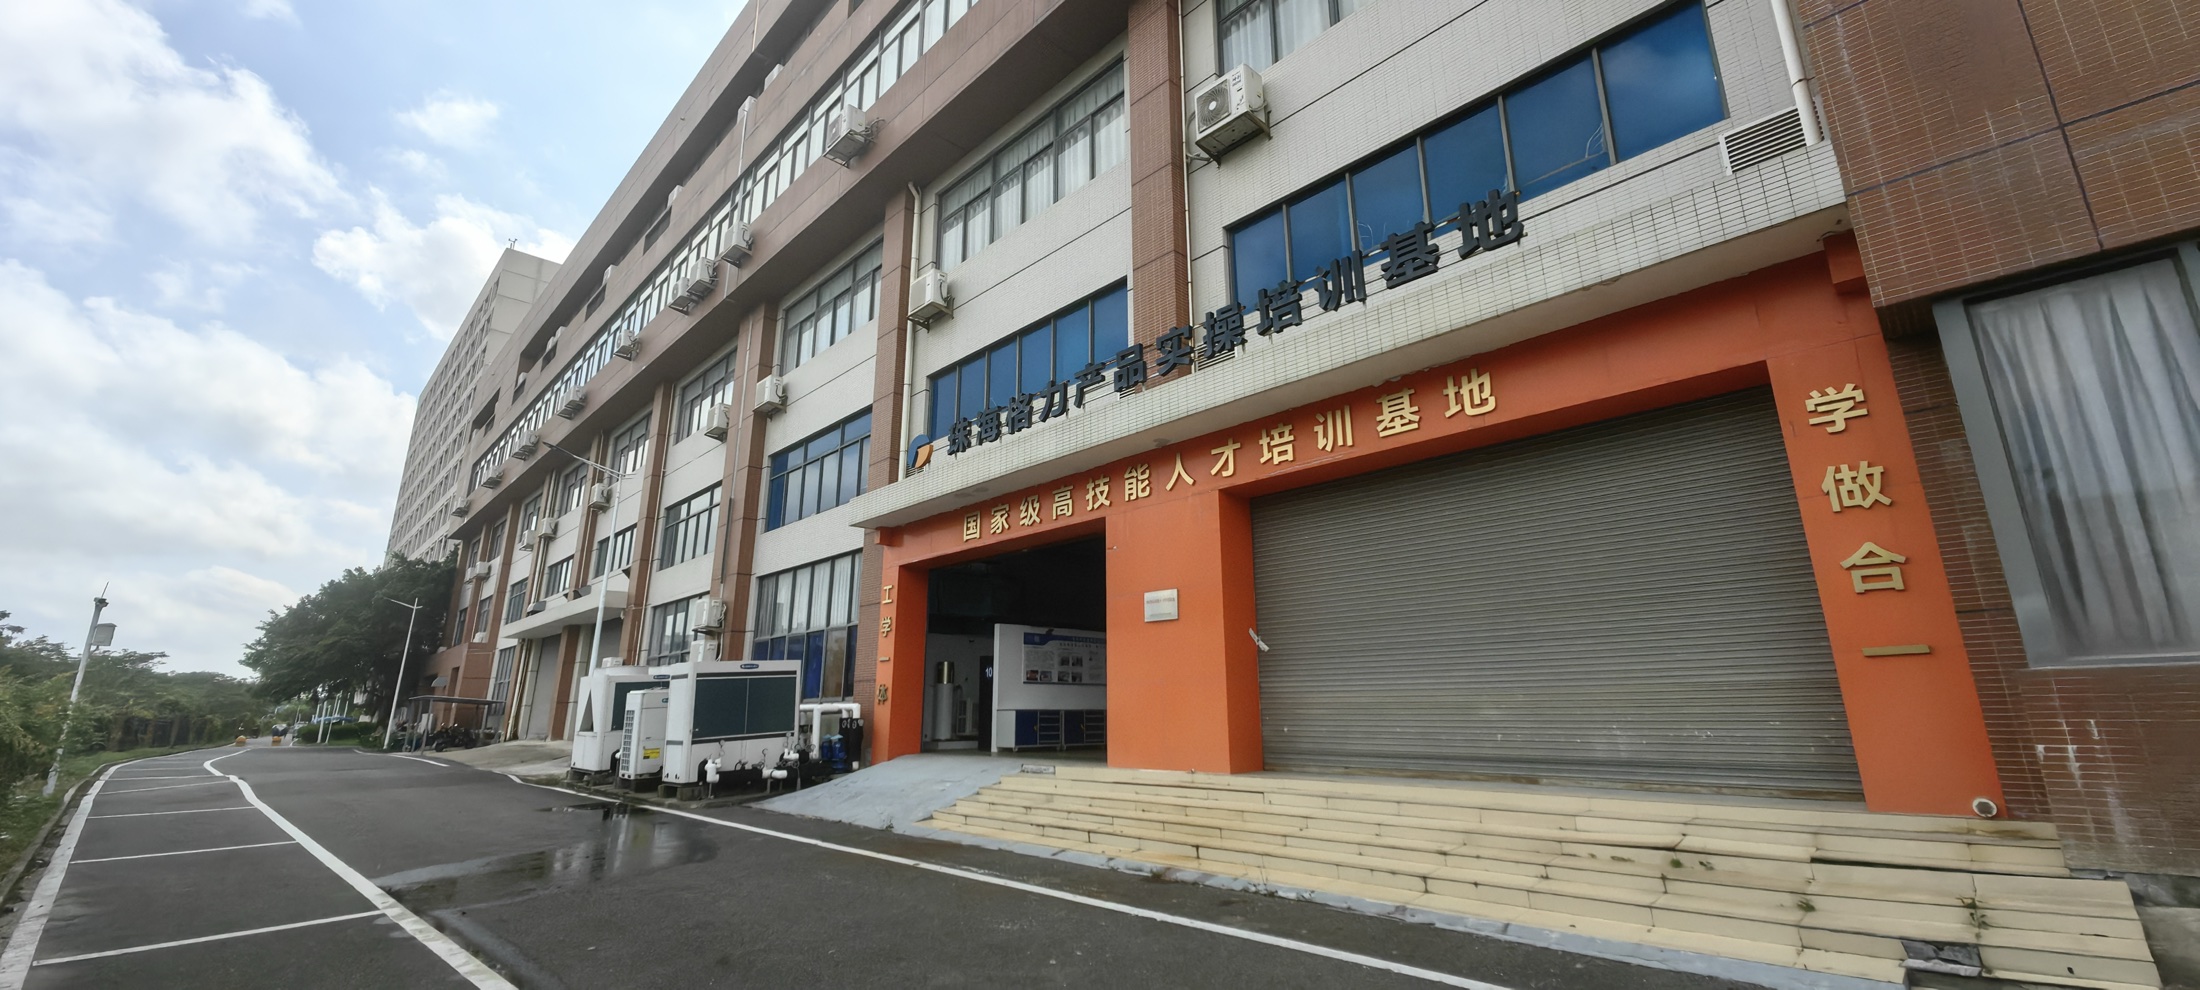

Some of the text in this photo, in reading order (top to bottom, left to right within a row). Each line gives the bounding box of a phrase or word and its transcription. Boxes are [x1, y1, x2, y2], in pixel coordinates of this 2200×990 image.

[947, 189, 1524, 455] 珠海格力产品实操培训基地
[963, 368, 1496, 542] 国家级高技能人才培训基地
[1805, 383, 1931, 657] 学做合一
[877, 585, 893, 705] 工学一体
